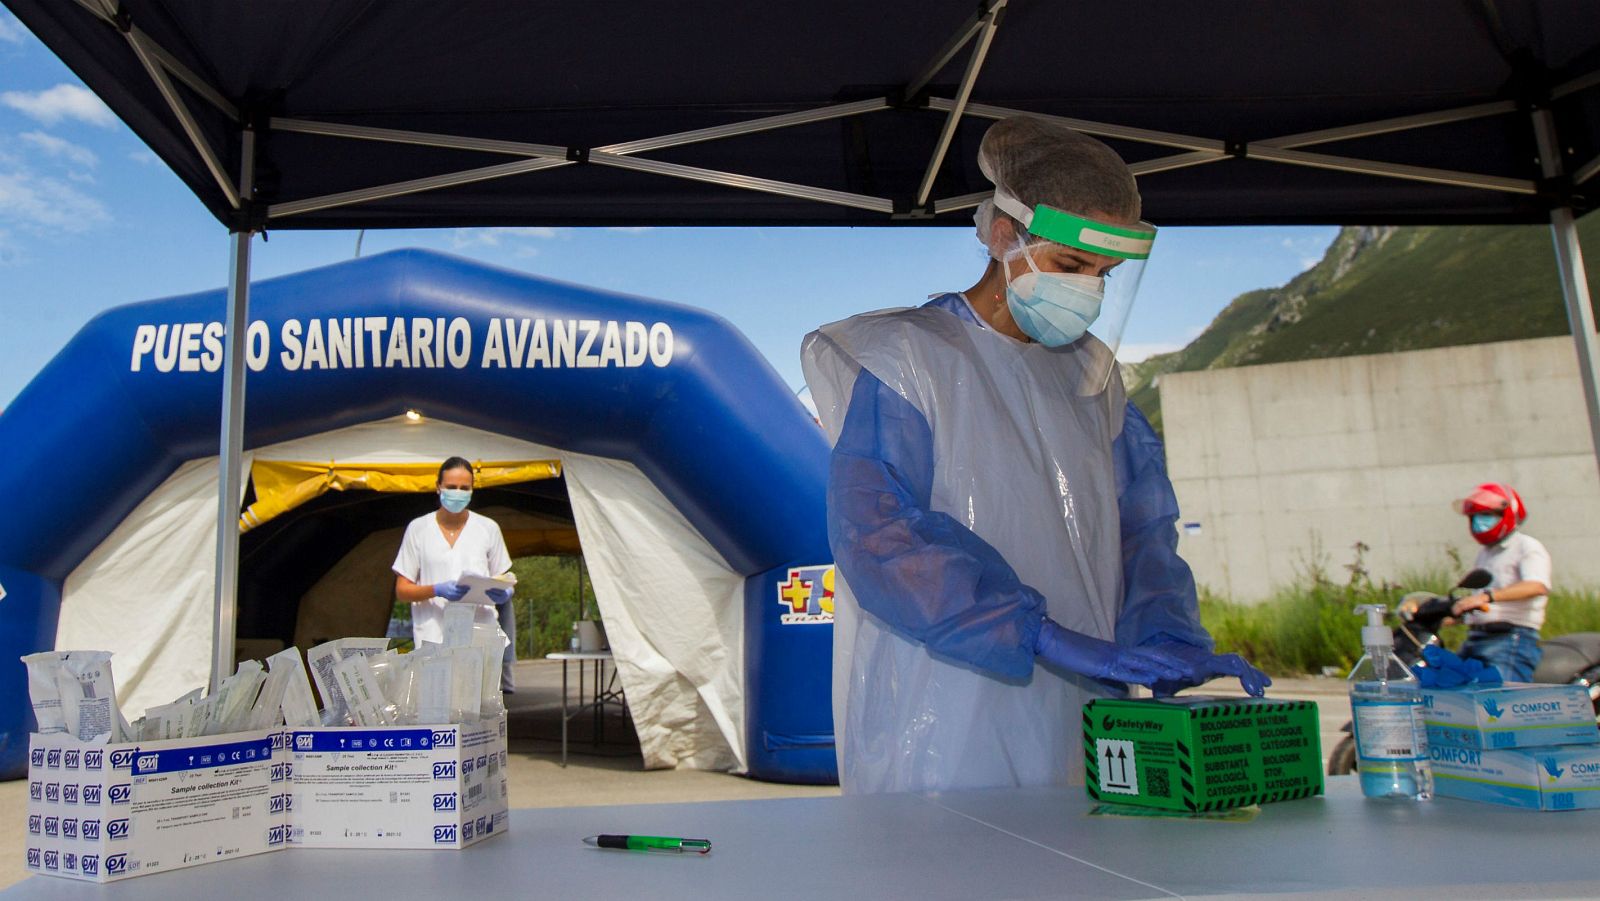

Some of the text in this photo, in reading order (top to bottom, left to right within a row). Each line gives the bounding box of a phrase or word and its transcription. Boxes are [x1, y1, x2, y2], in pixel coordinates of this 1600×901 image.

[130, 316, 674, 372] PUESO SANITARIO AVANZADO
[1512, 702, 1561, 713] COMFORT
[1116, 719, 1164, 732] SafetyWay
[1202, 733, 1224, 744] STOFF
[1430, 747, 1481, 765] OMFORT
[170, 785, 196, 794] Sample
[198, 781, 228, 790] collection
